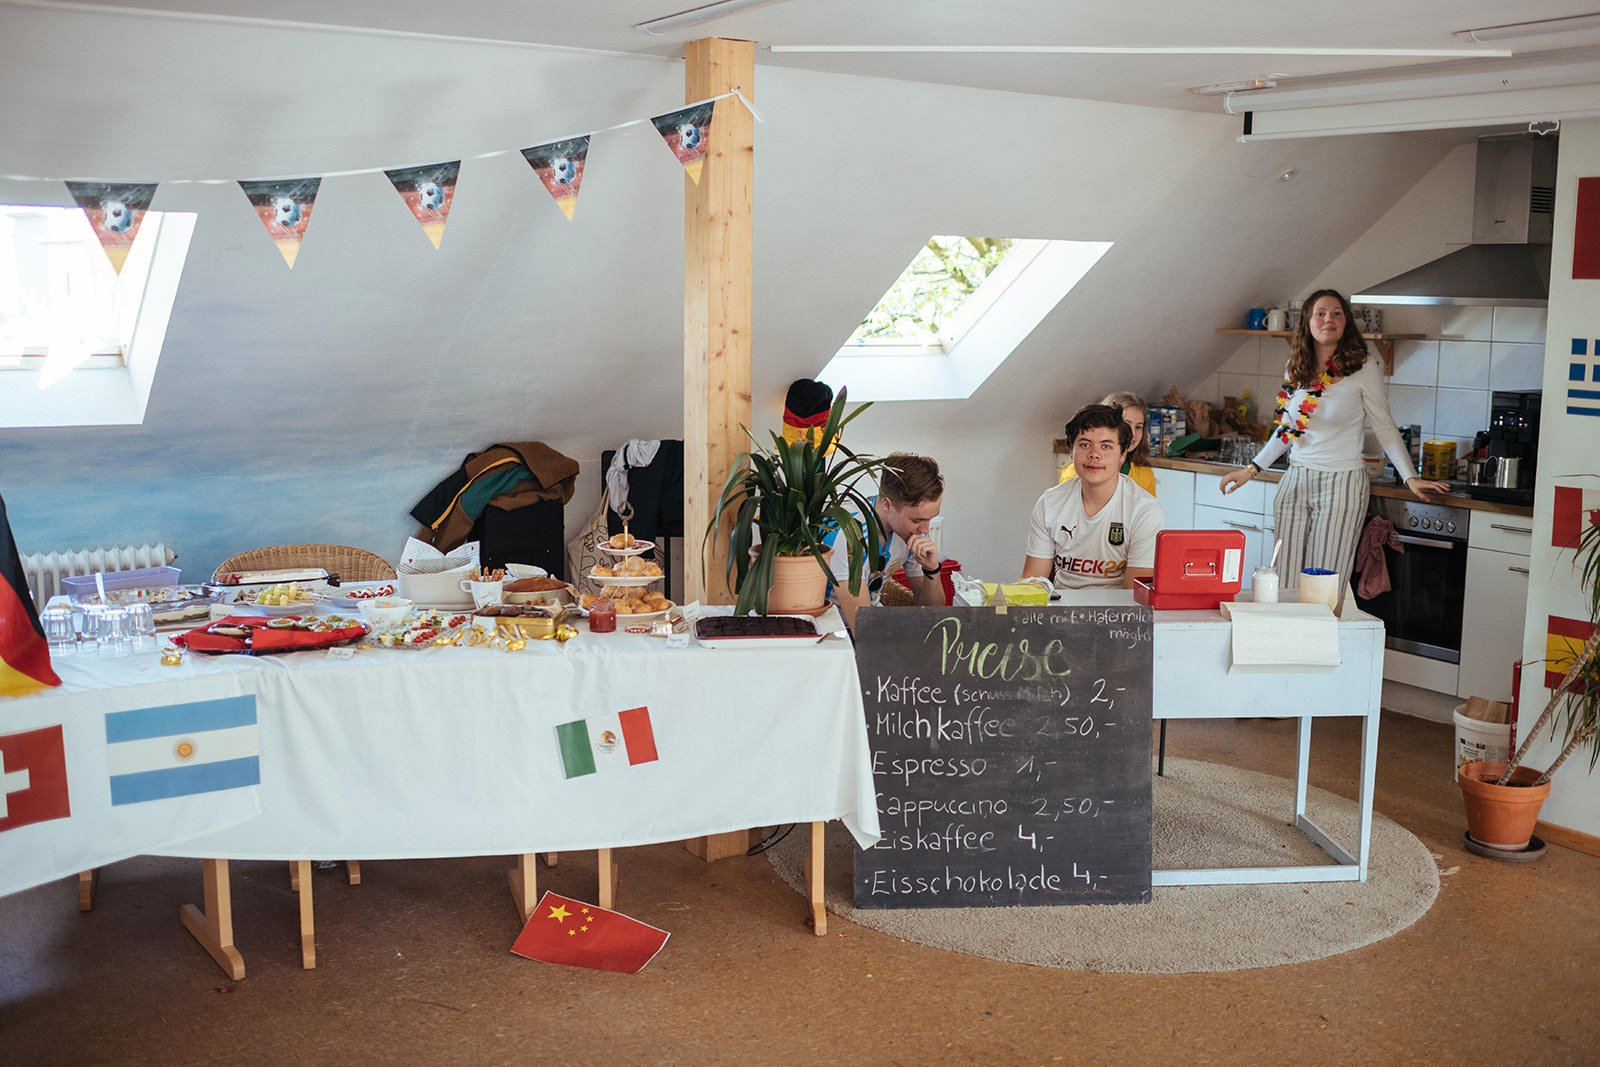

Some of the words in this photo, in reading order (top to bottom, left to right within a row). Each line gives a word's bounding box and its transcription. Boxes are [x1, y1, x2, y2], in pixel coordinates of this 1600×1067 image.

[1055, 555, 1127, 577] CHECK24
[923, 616, 1072, 682] Preise
[876, 675, 948, 704] Kaffee
[1090, 678, 1127, 710] 2,-
[876, 705, 1017, 745] Milchkaffee
[872, 750, 988, 787] Espresso
[1016, 755, 1058, 782] 1,-
[1033, 797, 1116, 822] 2,50,-
[1018, 824, 1055, 853] 4,-
[871, 863, 1062, 896] Eisschokolade
[1073, 861, 1109, 891] 4,-
